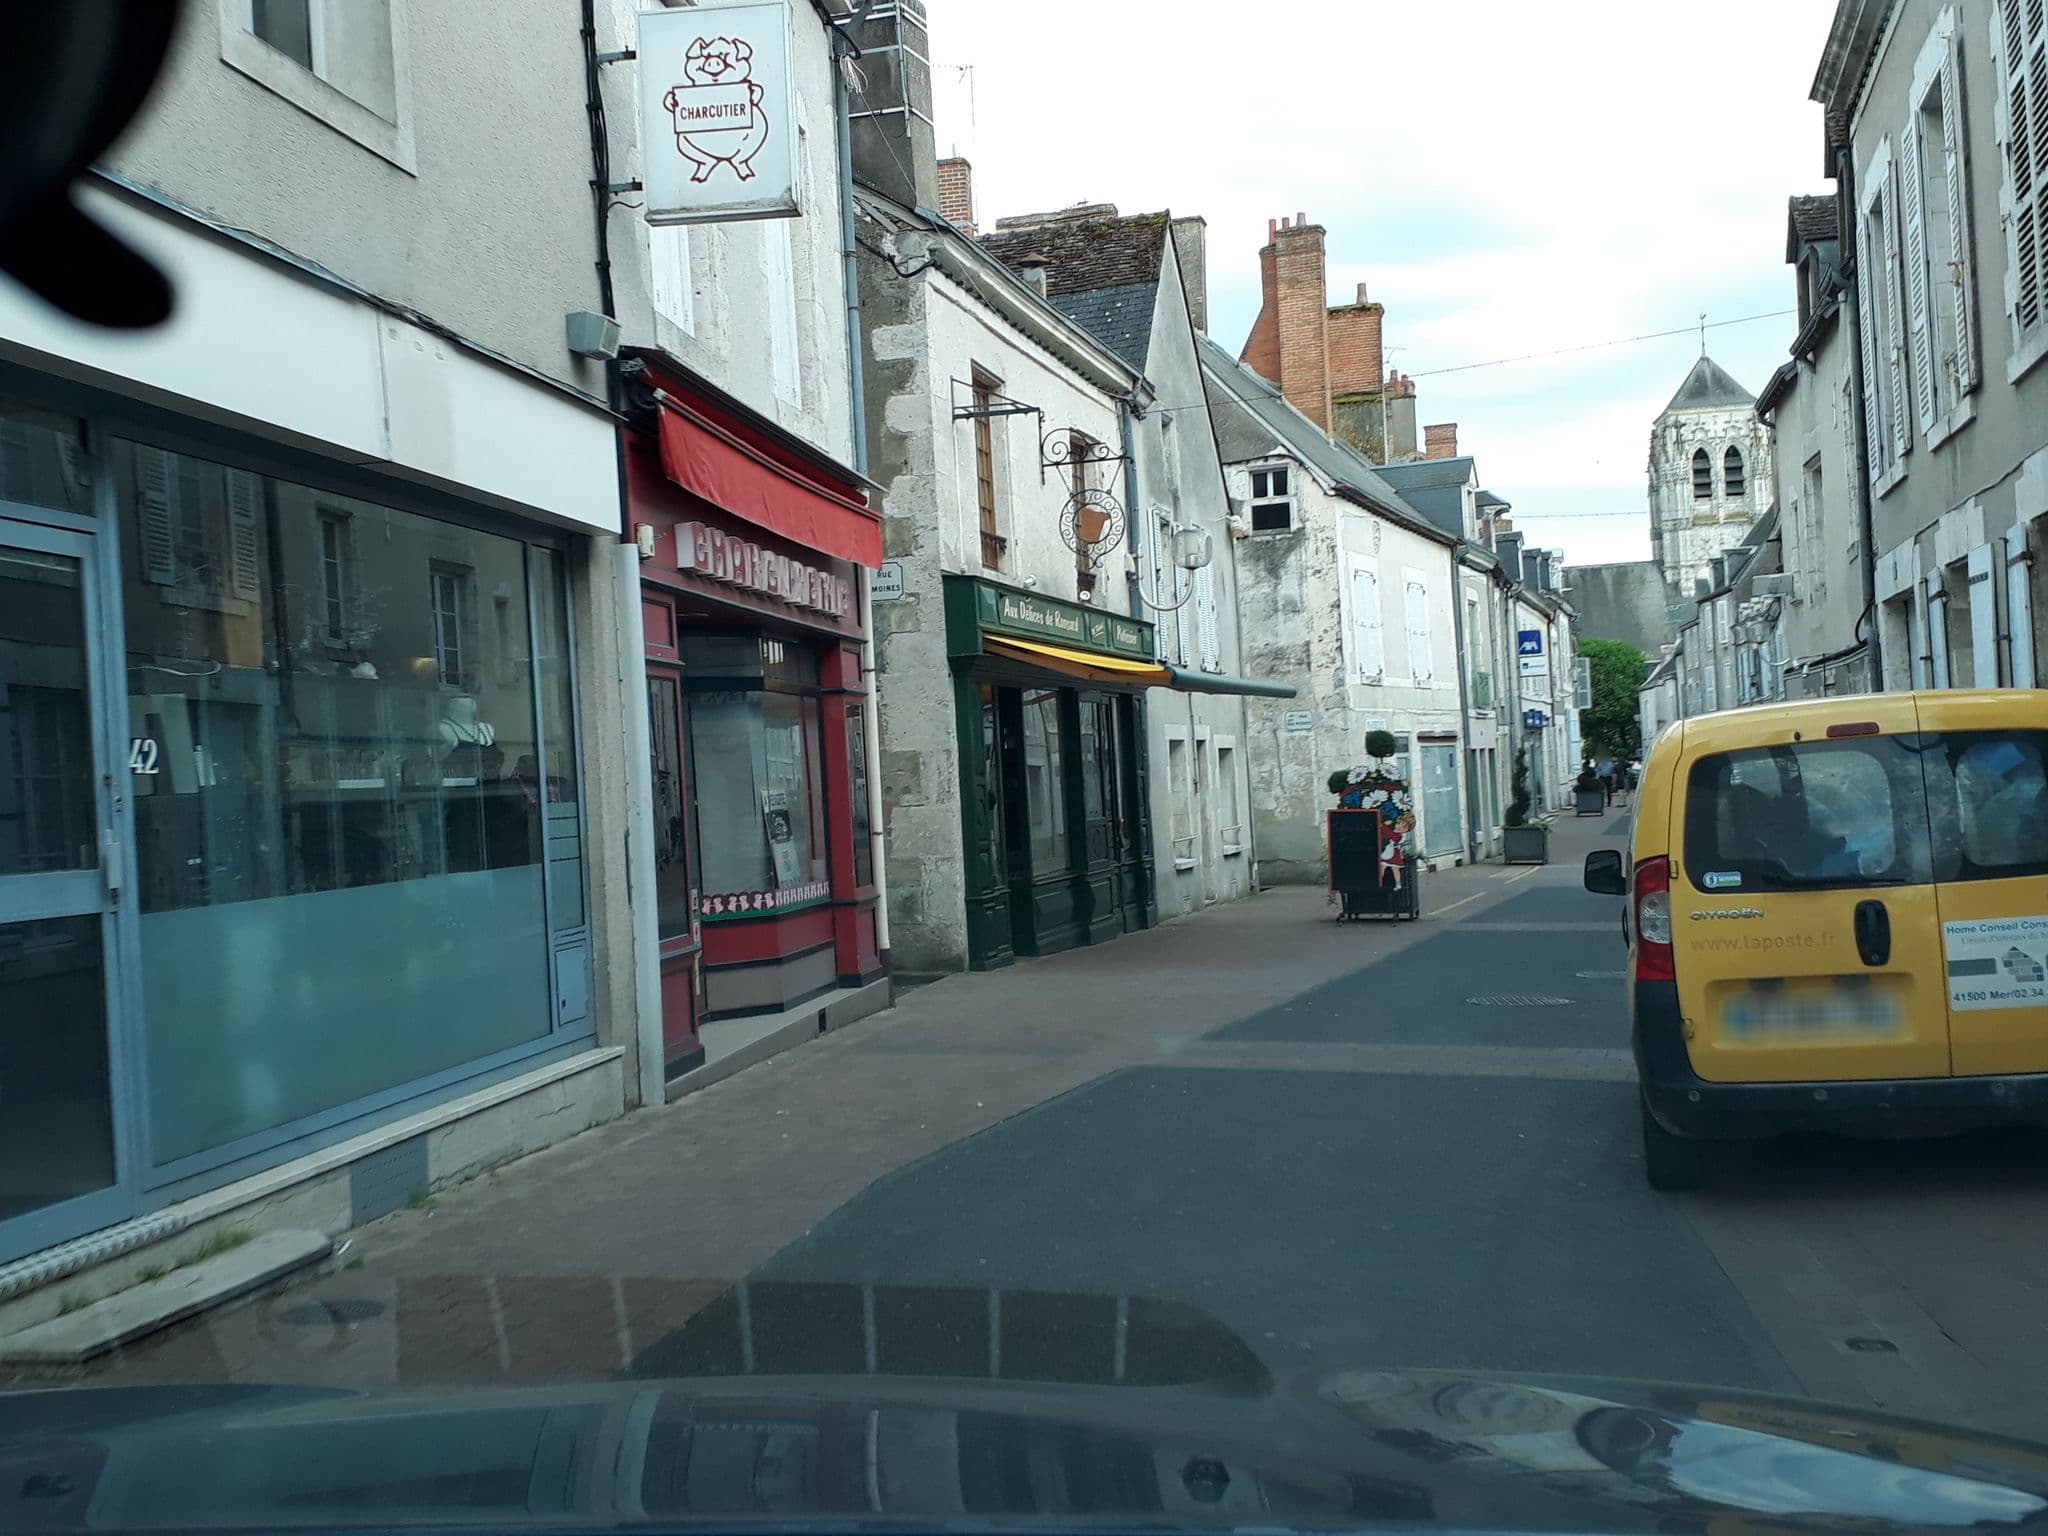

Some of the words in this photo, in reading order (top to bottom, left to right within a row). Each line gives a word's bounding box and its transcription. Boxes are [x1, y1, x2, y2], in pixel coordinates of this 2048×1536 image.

[680, 103, 746, 120] CHARCUTIER
[683, 521, 849, 618] CHARCUTERIE
[871, 584, 900, 592] MOINES
[1004, 598, 1018, 618] Aux
[1045, 609, 1053, 626] de
[1055, 611, 1078, 632] Ronsard
[129, 738, 159, 774] 42
[1690, 907, 1764, 920] CITROËN
[1946, 926, 1977, 934] Home
[1979, 922, 2018, 933] Conseil
[1690, 931, 1836, 952] www.laposte.fr
[1953, 991, 1986, 1002] 41500
